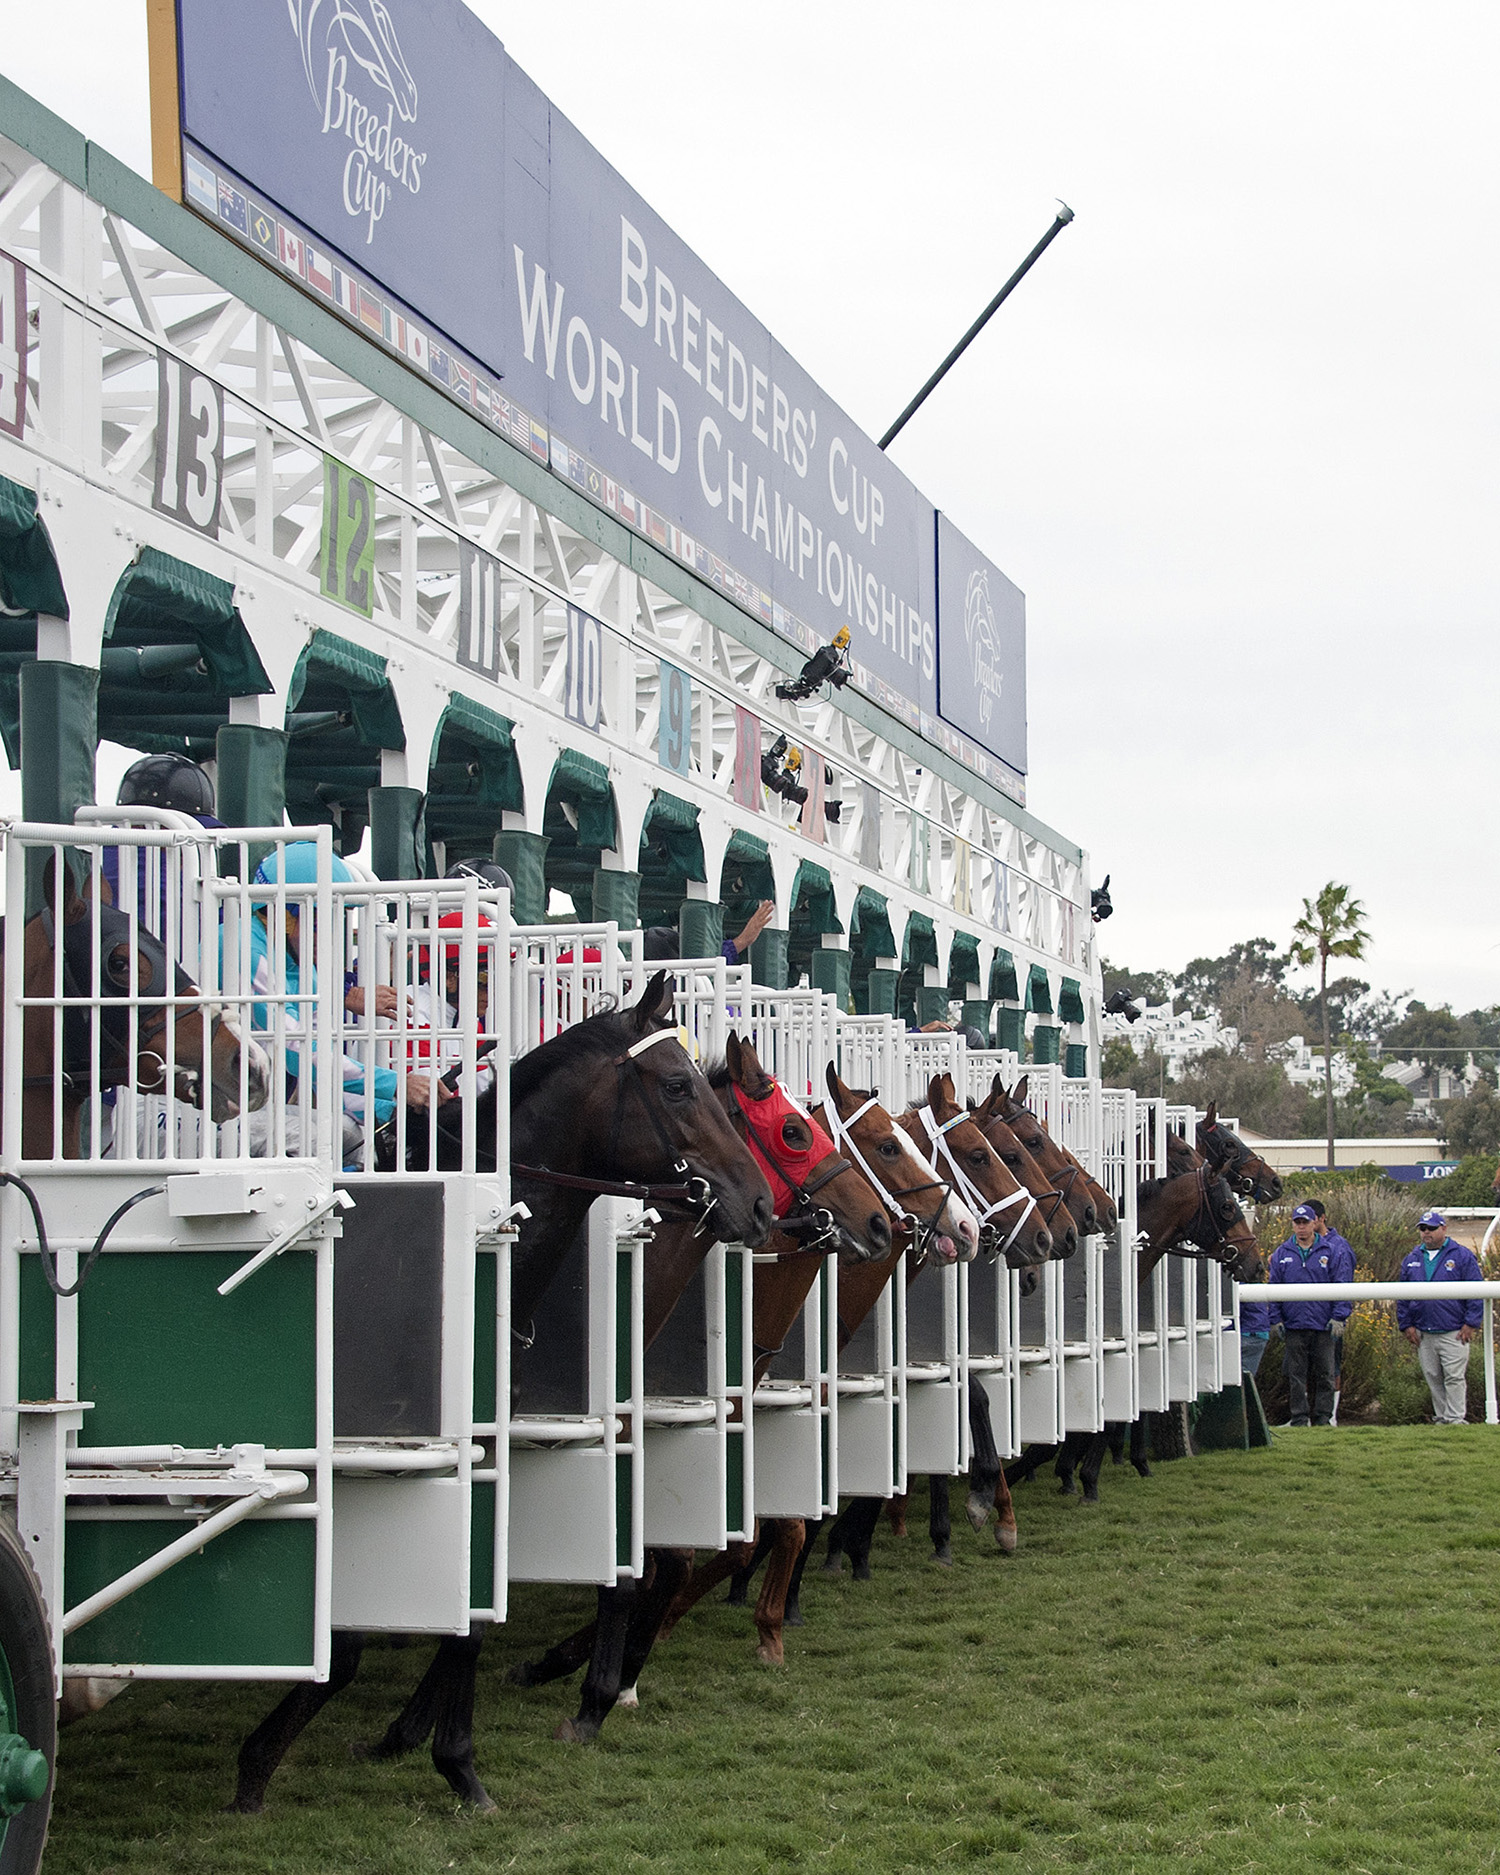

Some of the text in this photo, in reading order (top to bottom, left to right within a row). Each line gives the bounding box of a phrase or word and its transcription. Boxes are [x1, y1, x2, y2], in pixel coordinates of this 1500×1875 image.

[321, 47, 427, 194] Breeders'
[620, 214, 885, 547] BREEDERS' CUP
[162, 357, 219, 527] 13
[513, 243, 935, 681] WORLD CHAMPIONSHIPS
[326, 462, 370, 612] 12
[469, 553, 495, 670] 11
[569, 610, 599, 728] 10
[668, 669, 683, 770] 9
[741, 714, 756, 806] 8
[809, 748, 820, 834] 7
[914, 814, 924, 890] 5
[958, 843, 967, 912] 4
